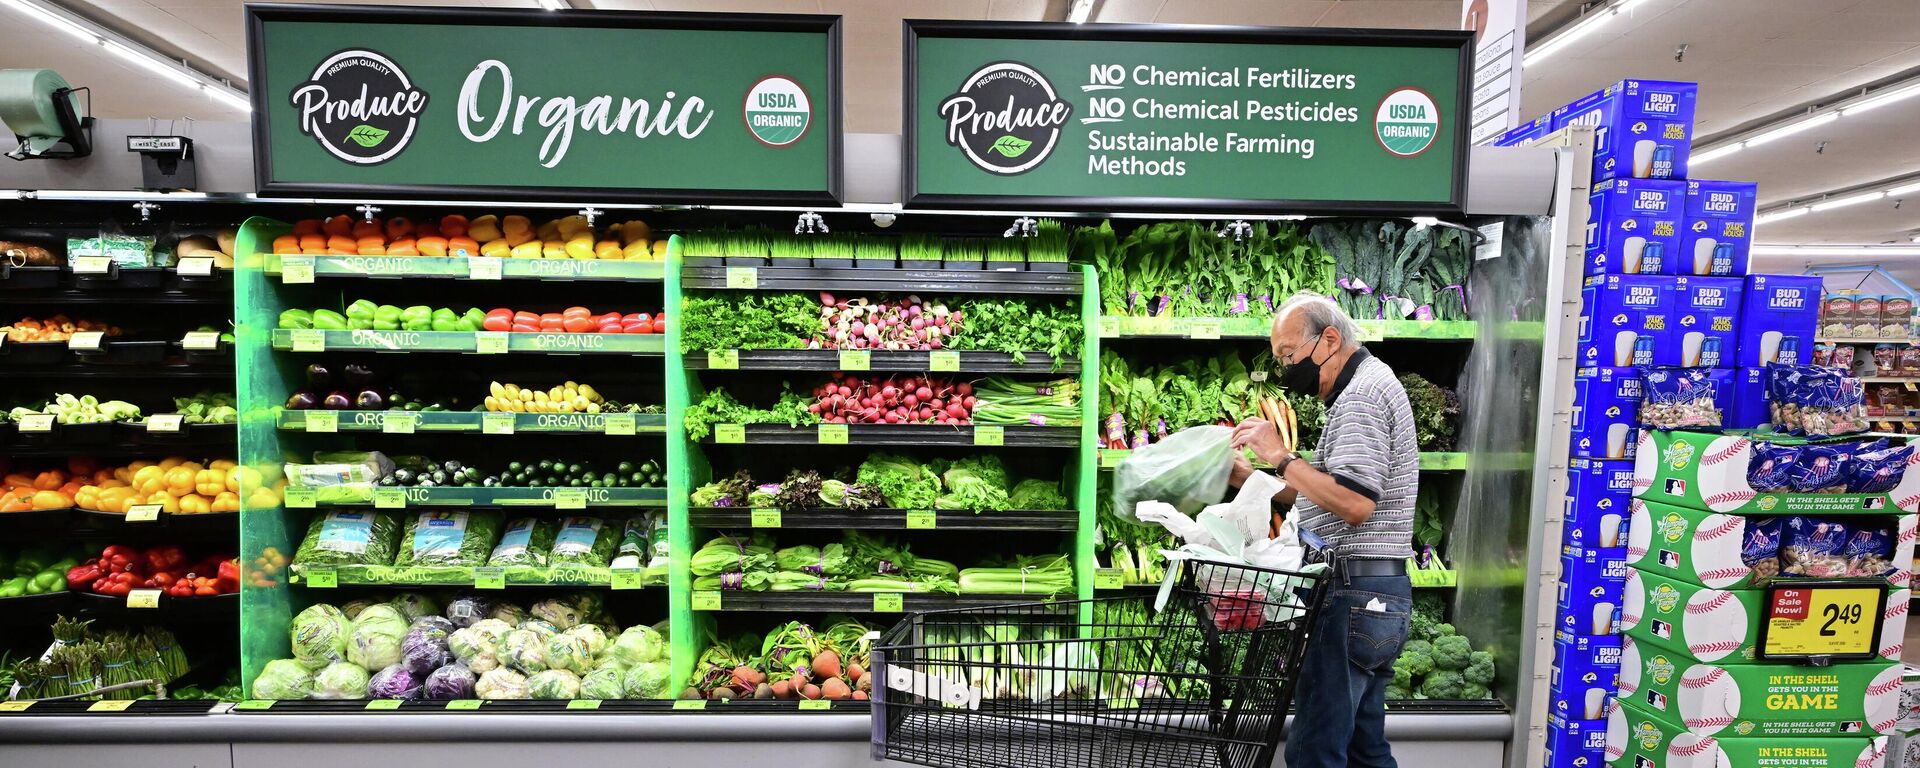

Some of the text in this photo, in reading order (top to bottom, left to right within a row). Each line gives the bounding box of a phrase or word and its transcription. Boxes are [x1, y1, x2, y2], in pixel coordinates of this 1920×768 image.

[326, 58, 390, 76] PREMIUM QUALITY
[976, 71, 1038, 88] PREMIUM QUALITY
[1090, 64, 1356, 90] NO Chemical Fertilizers
[758, 92, 797, 108] USDA
[1650, 94, 1673, 104] BUD
[292, 83, 426, 132] Produce
[1089, 97, 1359, 123] NO Chemical Pesticides
[1388, 104, 1426, 120] USDA
[1644, 102, 1676, 112] LIGHT
[457, 59, 714, 168] Organic
[941, 94, 1070, 143] Produce
[753, 114, 802, 128] ORGANIC
[1383, 125, 1430, 138] ORGANIC
[1088, 130, 1316, 159] Sustainable Farming
[1088, 154, 1186, 177] Methods
[1654, 160, 1672, 168] BUD
[1650, 168, 1672, 176] LIGHT
[1640, 192, 1662, 200] BUD
[1710, 193, 1733, 202] BUD
[1634, 200, 1666, 210] LIGHT
[1705, 202, 1736, 212] LIGHT
[344, 256, 413, 272] ORGANIC
[530, 260, 598, 274] ORGANIC
[1710, 265, 1732, 273] LIGHT
[1630, 286, 1654, 296] BUD
[1699, 288, 1721, 297] BUD
[1776, 288, 1799, 298] BUD
[1626, 296, 1657, 305] LIGHT
[1693, 297, 1724, 306] LIGHT
[1770, 298, 1803, 308] LIGHT
[352, 331, 420, 346] ORGANIC
[536, 334, 604, 348] ORGANIC
[1635, 350, 1652, 358] BUD
[1624, 380, 1641, 388] BU
[1618, 388, 1642, 397] LIGH
[355, 412, 423, 426] ORGC
[538, 414, 605, 427] ORGANIC
[1609, 480, 1633, 488] LIGH
[366, 569, 432, 582] ORGANIC
[546, 570, 611, 582] ORGANIC
[1602, 569, 1626, 577] LIGH
[1769, 675, 1839, 684] IN THE SHELL
[1766, 694, 1838, 710] GAME
[1759, 748, 1827, 757] IN THE SHELL
